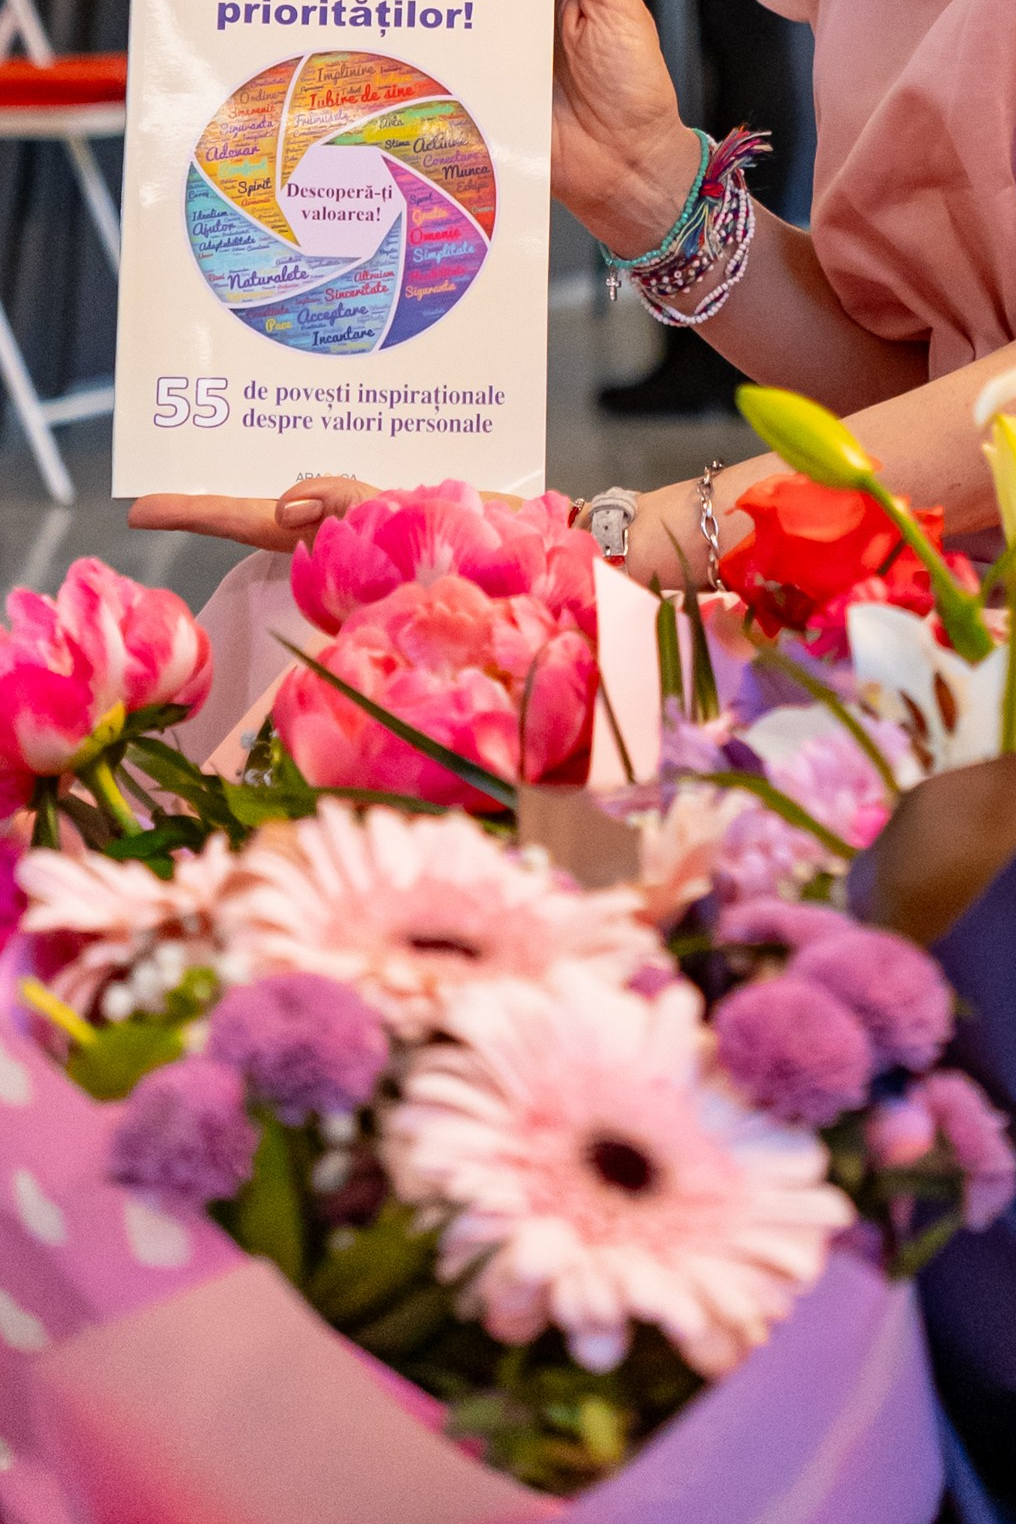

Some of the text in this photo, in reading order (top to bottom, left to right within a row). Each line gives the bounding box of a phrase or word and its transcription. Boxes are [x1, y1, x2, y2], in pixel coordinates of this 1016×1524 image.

[309, 89, 358, 111] Iubire
[361, 83, 380, 105] de
[384, 84, 415, 99] sine
[205, 143, 260, 162] Adevar
[442, 164, 490, 180] Munca
[237, 177, 272, 197] Spirit
[287, 183, 392, 202] Descoperă-ți
[191, 208, 228, 222] Idealism
[301, 206, 380, 222] valoarea!
[192, 219, 236, 239] Ajutor
[227, 265, 310, 291] Naturalete
[324, 281, 390, 303] Sinceritate
[297, 302, 369, 326] Acceptare
[312, 326, 376, 347] Incantare
[153, 376, 506, 429] 55 de povești inspiraționale
[242, 408, 494, 437] despre valori personale
